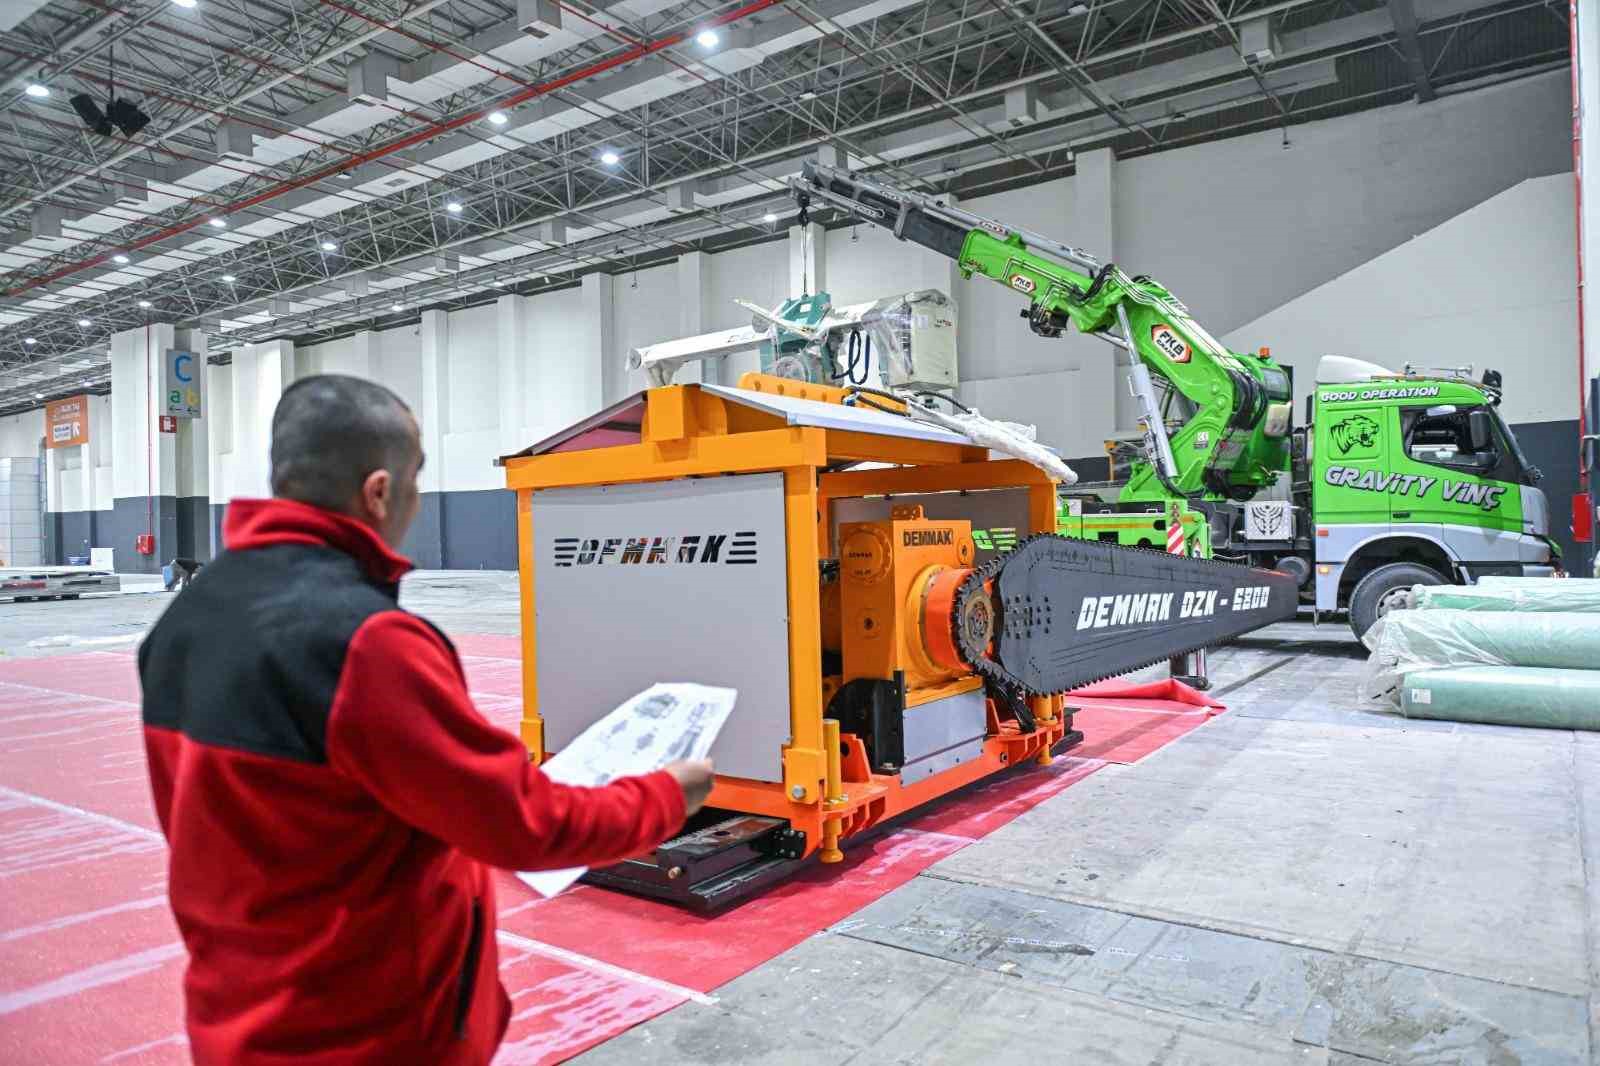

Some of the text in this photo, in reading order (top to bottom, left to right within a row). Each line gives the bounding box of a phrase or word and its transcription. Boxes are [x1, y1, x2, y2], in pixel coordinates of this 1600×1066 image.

[1159, 330, 1185, 355] FKB
[175, 354, 193, 382] C
[170, 390, 181, 404] a
[1321, 386, 1440, 402] GOOD OPERATION
[903, 527, 953, 547] DEMMAK
[1076, 592, 1175, 631] DEMMAK
[1179, 590, 1219, 618] DZK
